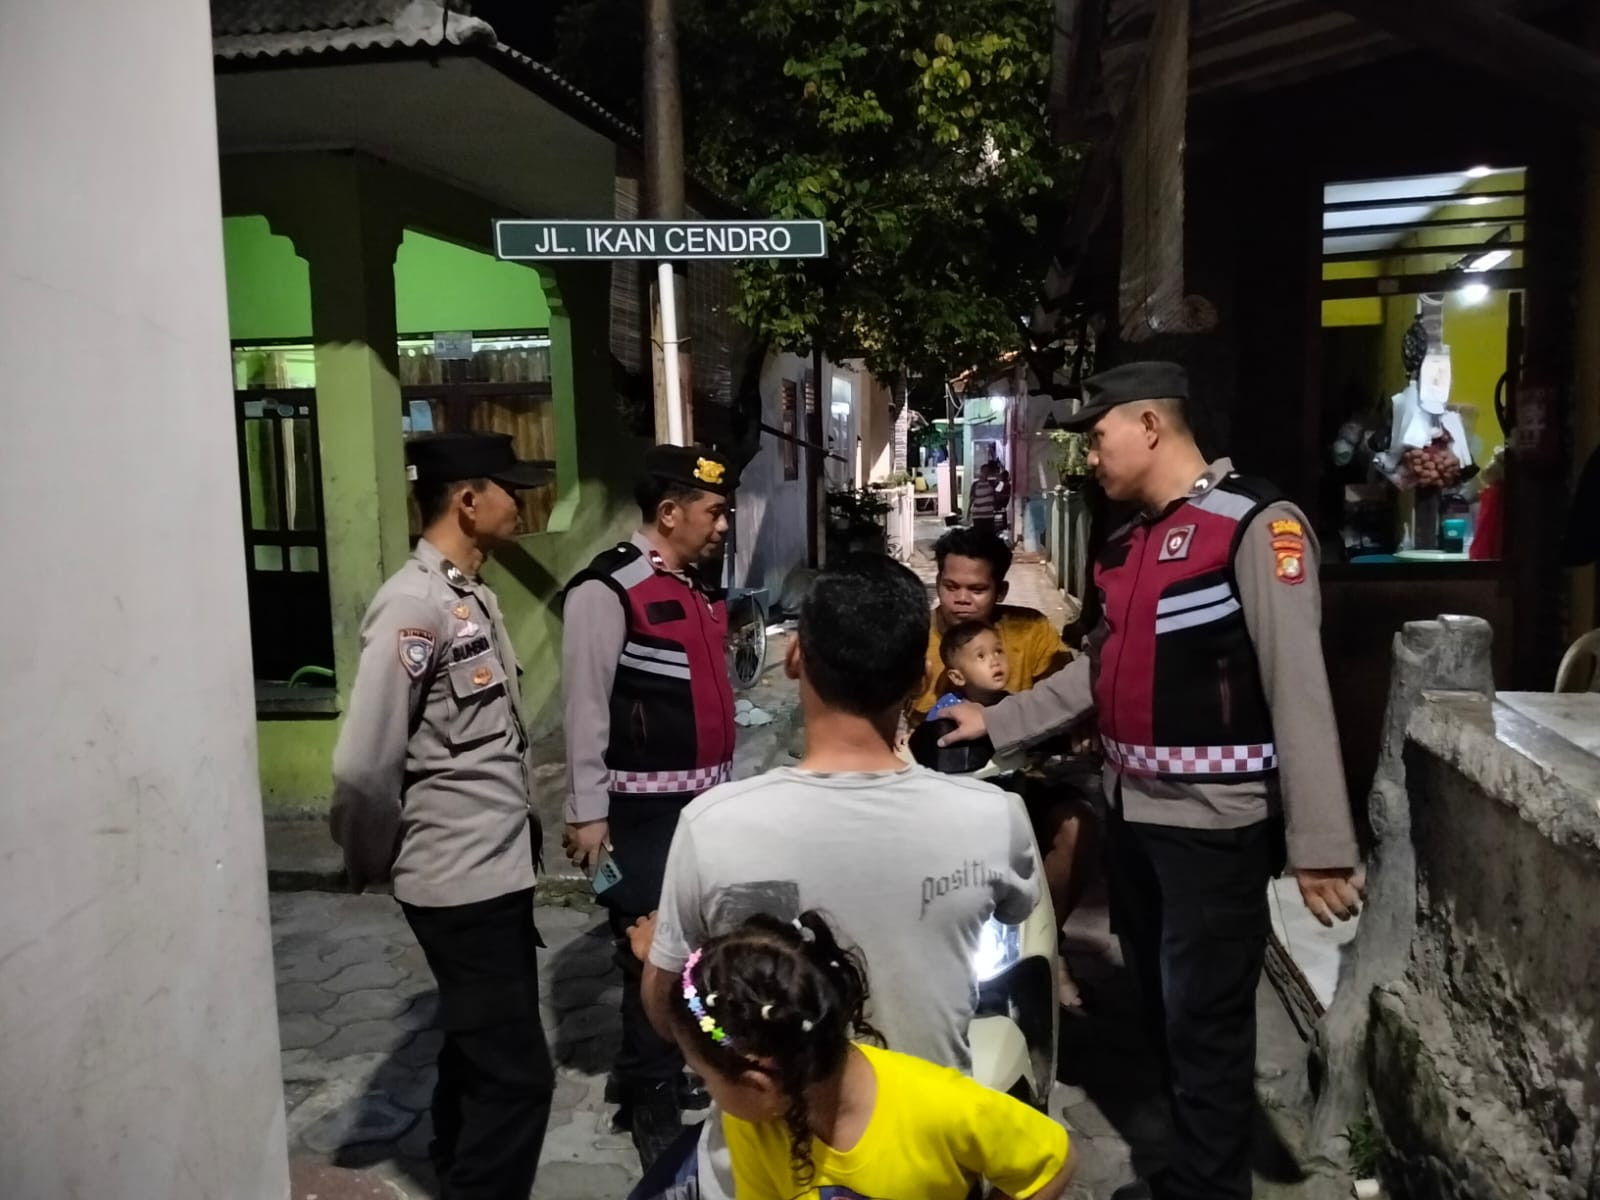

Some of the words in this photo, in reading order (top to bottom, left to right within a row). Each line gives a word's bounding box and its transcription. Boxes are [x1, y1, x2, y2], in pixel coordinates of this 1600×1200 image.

[534, 227, 576, 253] JL.
[585, 227, 656, 253] IKAN
[664, 226, 791, 252] CENDRO
